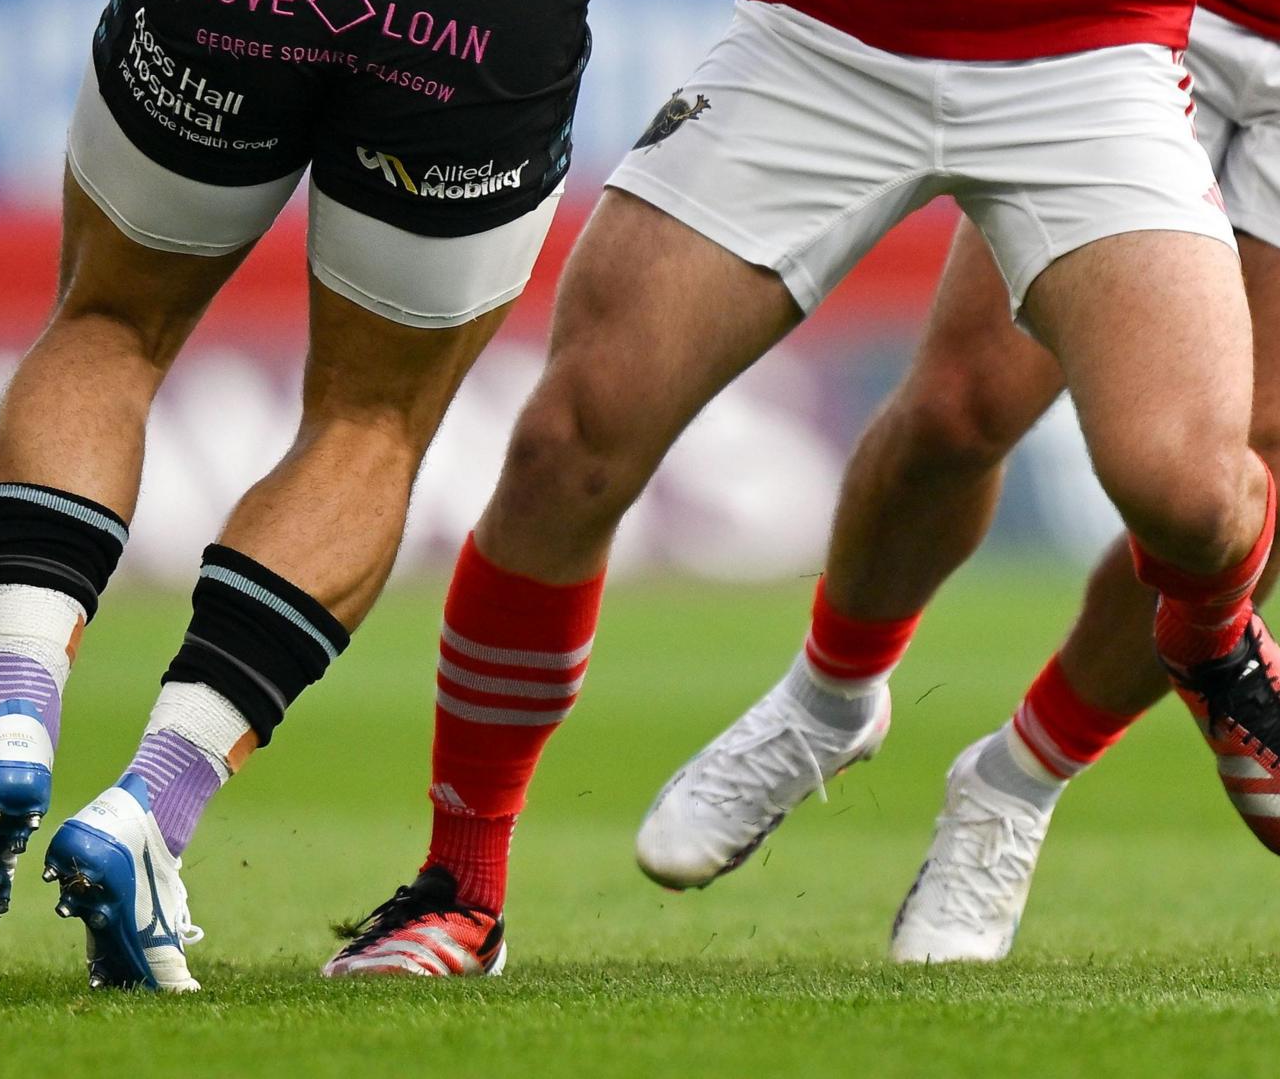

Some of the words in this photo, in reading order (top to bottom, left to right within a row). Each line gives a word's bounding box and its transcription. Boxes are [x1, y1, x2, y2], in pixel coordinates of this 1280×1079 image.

[196, 28, 274, 59] GEORGE
[381, 2, 493, 64] LOAN
[129, 32, 223, 133] Hospital
[133, 6, 176, 77] Ross
[179, 67, 244, 116] Hall
[179, 125, 229, 150] Health
[231, 137, 279, 151] Group
[424, 159, 494, 183] Allied
